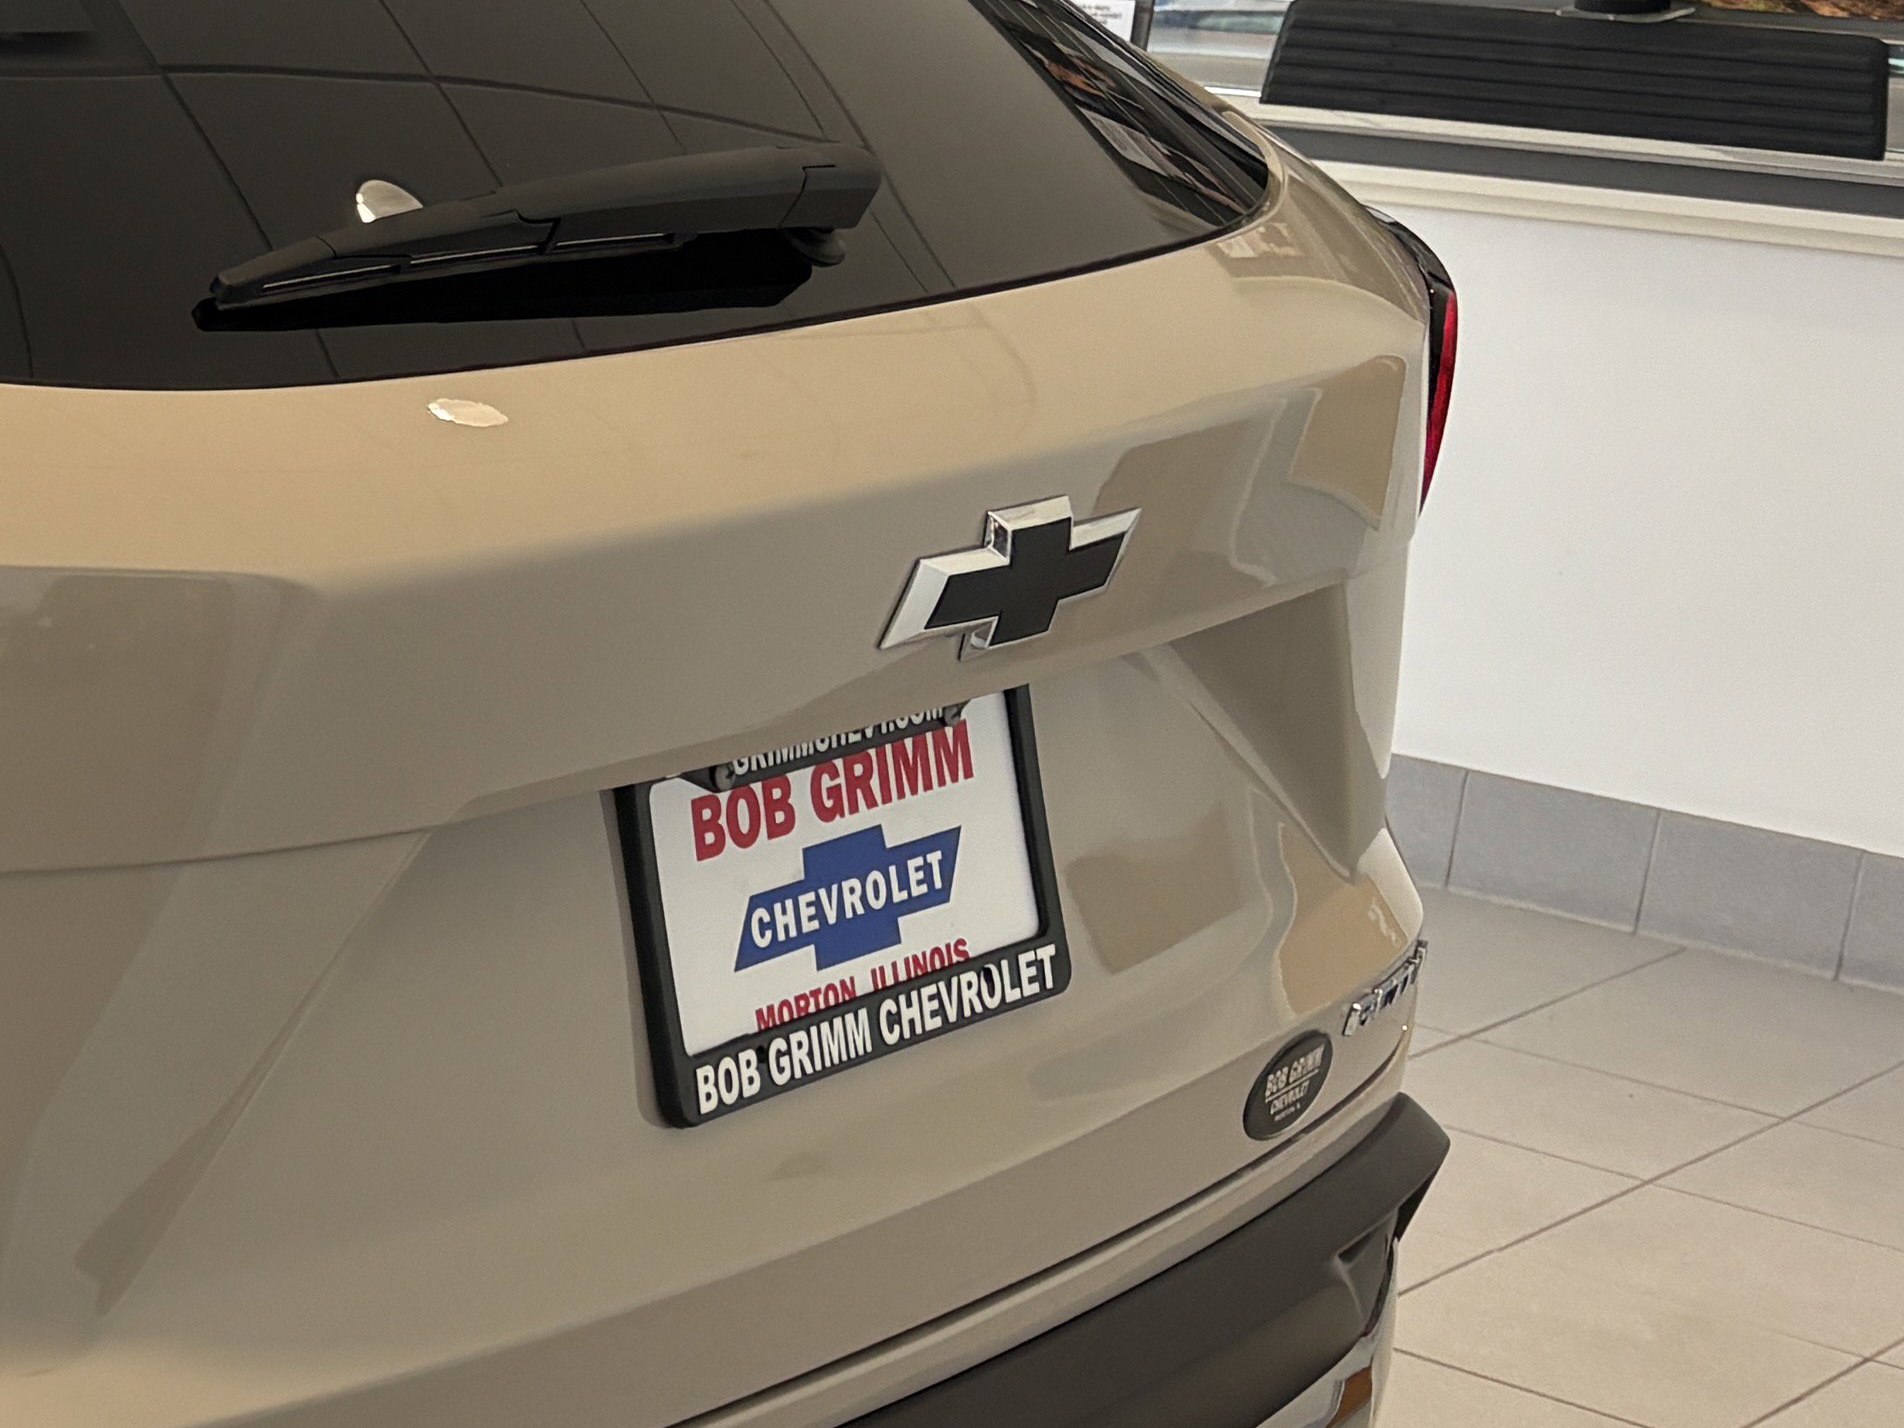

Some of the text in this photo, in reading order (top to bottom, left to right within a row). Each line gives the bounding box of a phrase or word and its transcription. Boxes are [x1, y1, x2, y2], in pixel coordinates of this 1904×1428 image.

[690, 717, 975, 862] BOB GRIMM
[749, 849, 944, 949] CHEVROLET
[695, 943, 1057, 1116] BOB GRIMM CHEVROLET
